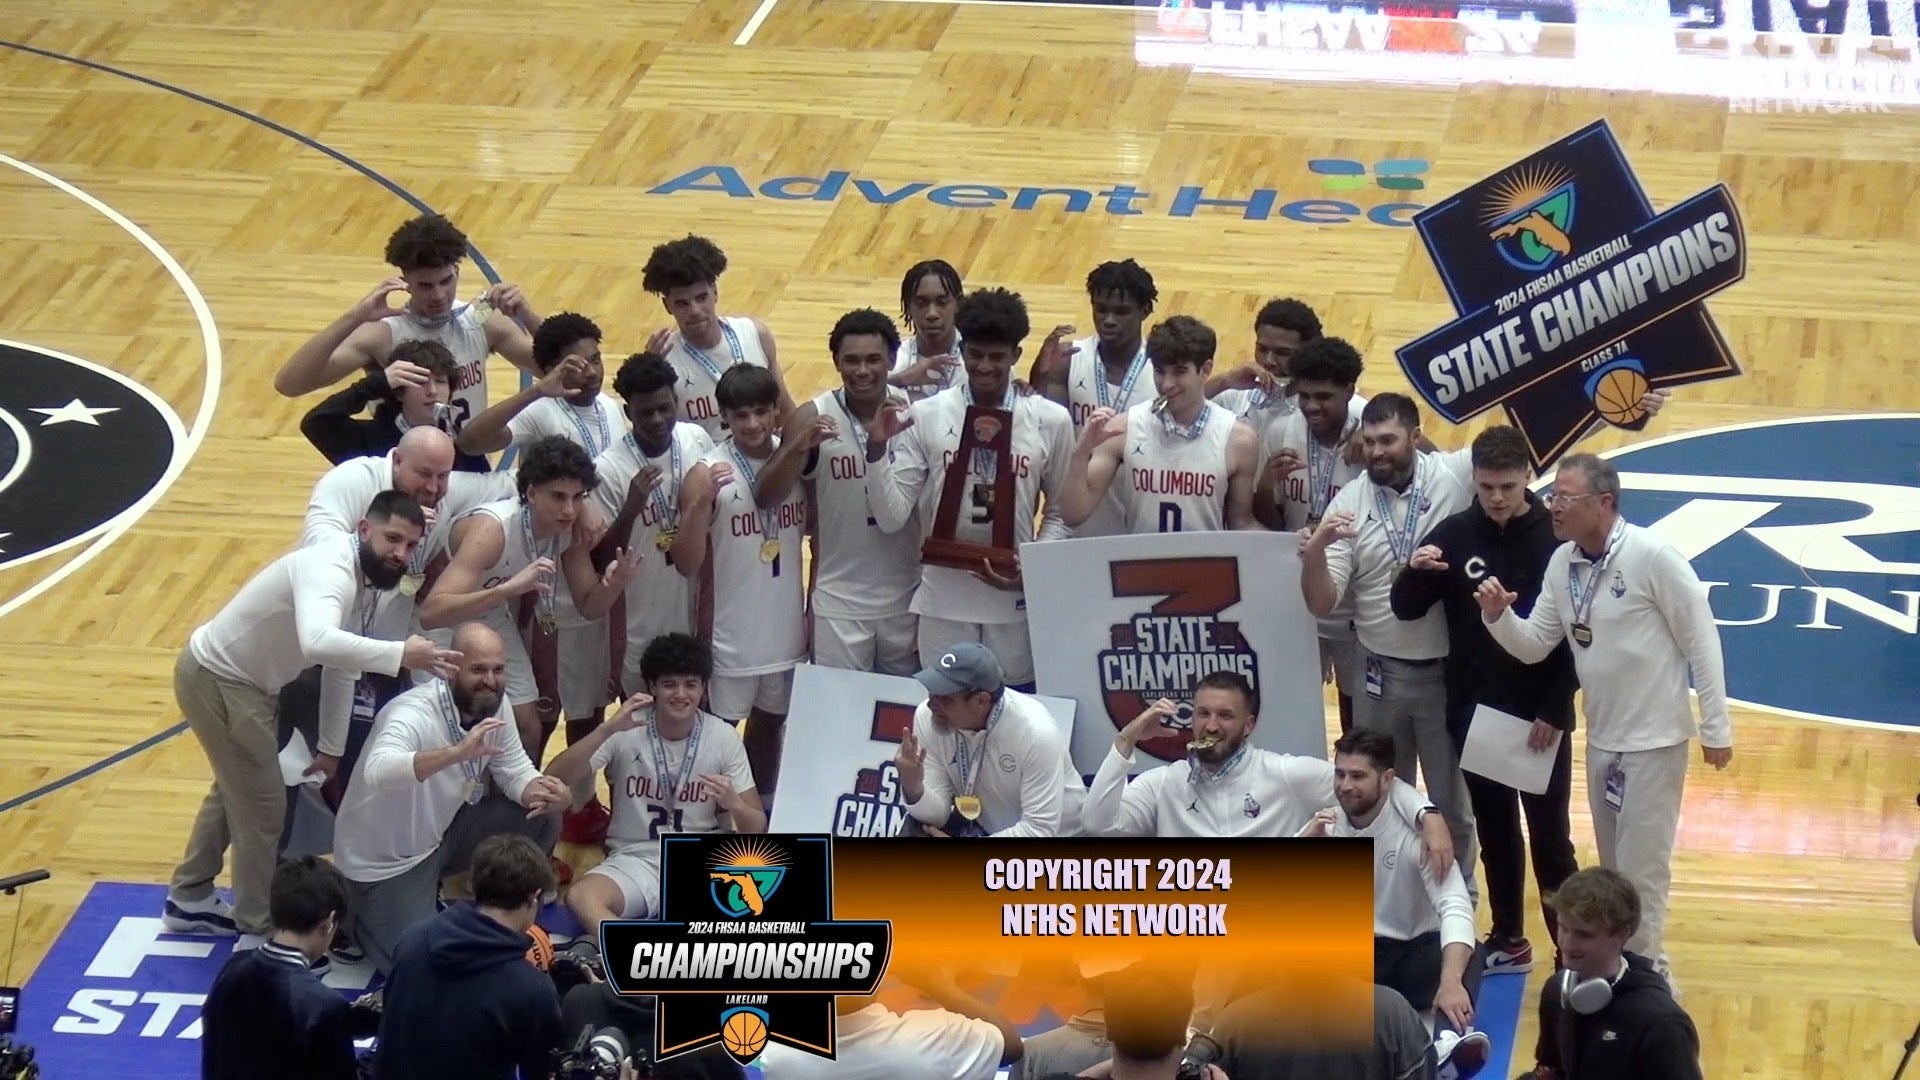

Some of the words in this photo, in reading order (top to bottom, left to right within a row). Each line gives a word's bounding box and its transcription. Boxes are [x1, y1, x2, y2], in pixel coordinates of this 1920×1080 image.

[1494, 291, 1526, 316] 2024
[1525, 273, 1564, 299] FHSAA
[1562, 234, 1633, 281] BASKETBALL
[1427, 316, 1533, 406] STATE
[1529, 211, 1738, 353] CHAMPIONS
[1581, 347, 1614, 374] CLASS
[1613, 340, 1629, 359] 7A
[1132, 468, 1216, 497] COLUMBUS
[1135, 616, 1217, 653] STATE
